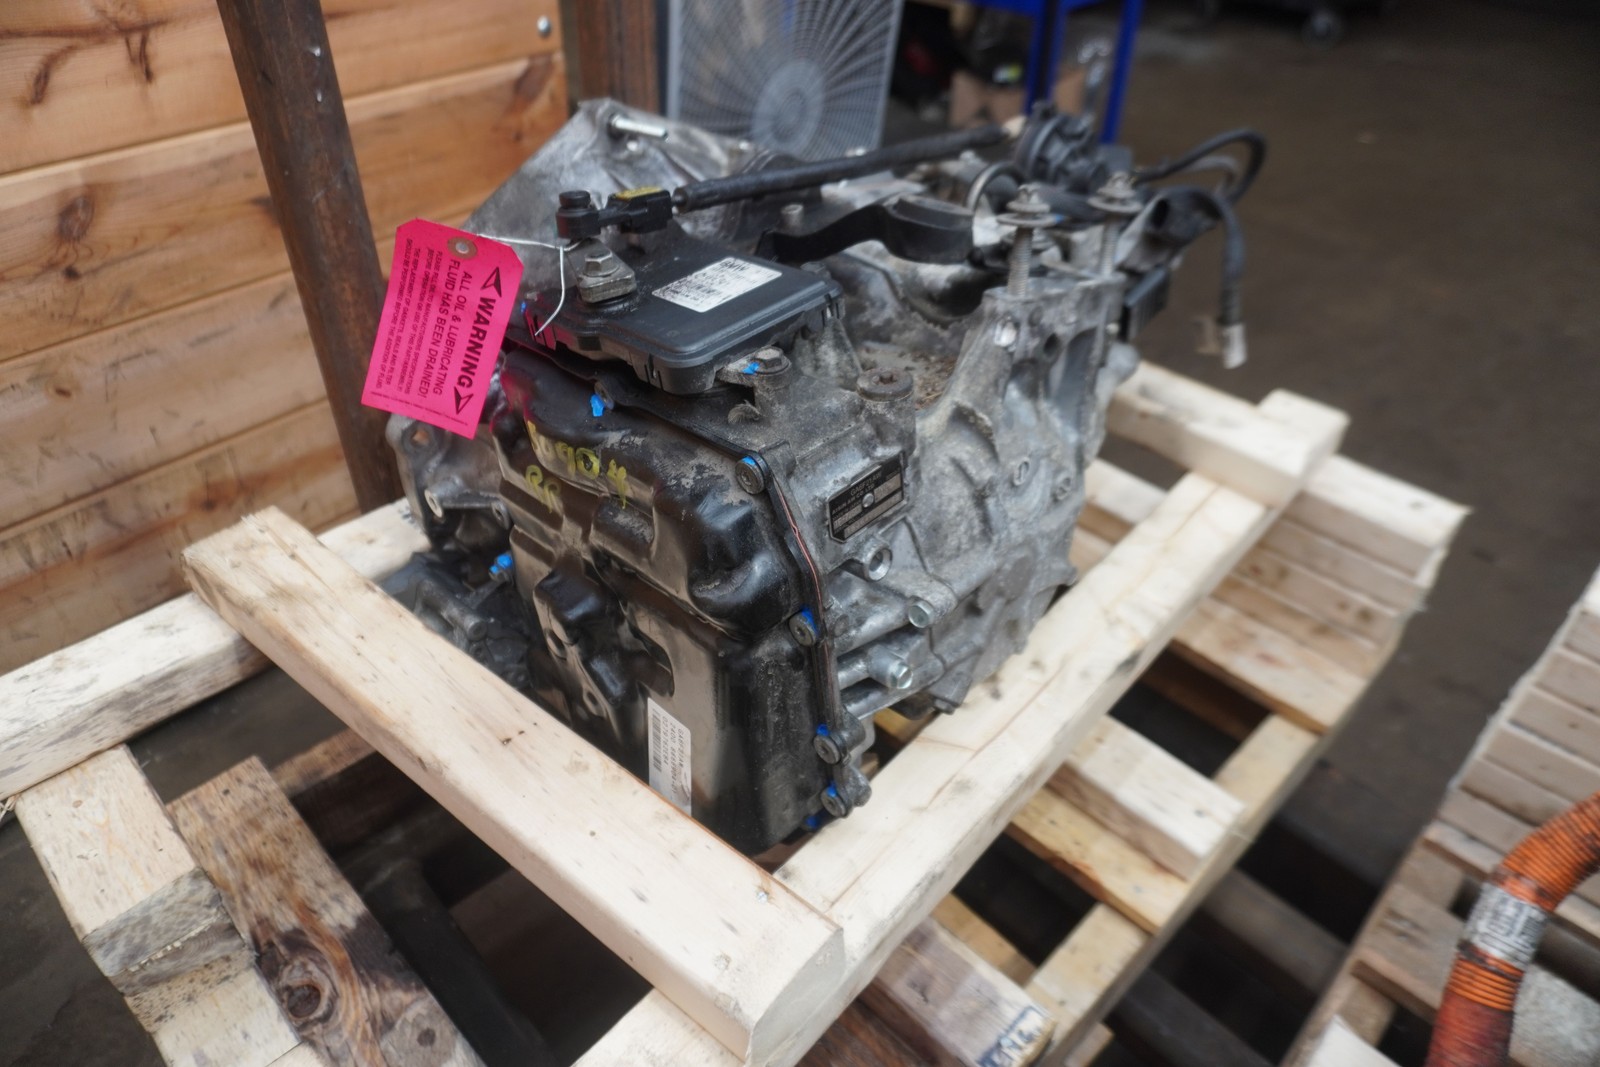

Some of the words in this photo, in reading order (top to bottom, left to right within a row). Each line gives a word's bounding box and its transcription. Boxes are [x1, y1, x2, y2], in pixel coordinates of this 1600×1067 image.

[402, 238, 413, 259] SHOULD
[424, 249, 435, 269] BEFORE
[432, 250, 443, 271] PLEASE
[394, 267, 409, 301] PERFORMED
[404, 258, 420, 297] REPLACEMENT
[417, 270, 430, 301] OPERATION
[430, 271, 438, 284] FILL
[443, 258, 461, 291] FLUID
[458, 271, 472, 292] ALL
[391, 301, 401, 324] BEFORE
[438, 292, 452, 315] HAS
[453, 294, 466, 313] OIL
[451, 314, 460, 323] &
[430, 317, 446, 346] BEEN
[456, 295, 496, 389] WARNING
[382, 337, 392, 363] ADDITION
[392, 335, 401, 353] SEALS
[389, 353, 397, 366] AND
[432, 325, 458, 395] LUBRICATING
[384, 366, 394, 385] FILTER
[403, 351, 419, 394] SPECIFICATIONS
[417, 348, 438, 397] DRAINED!
